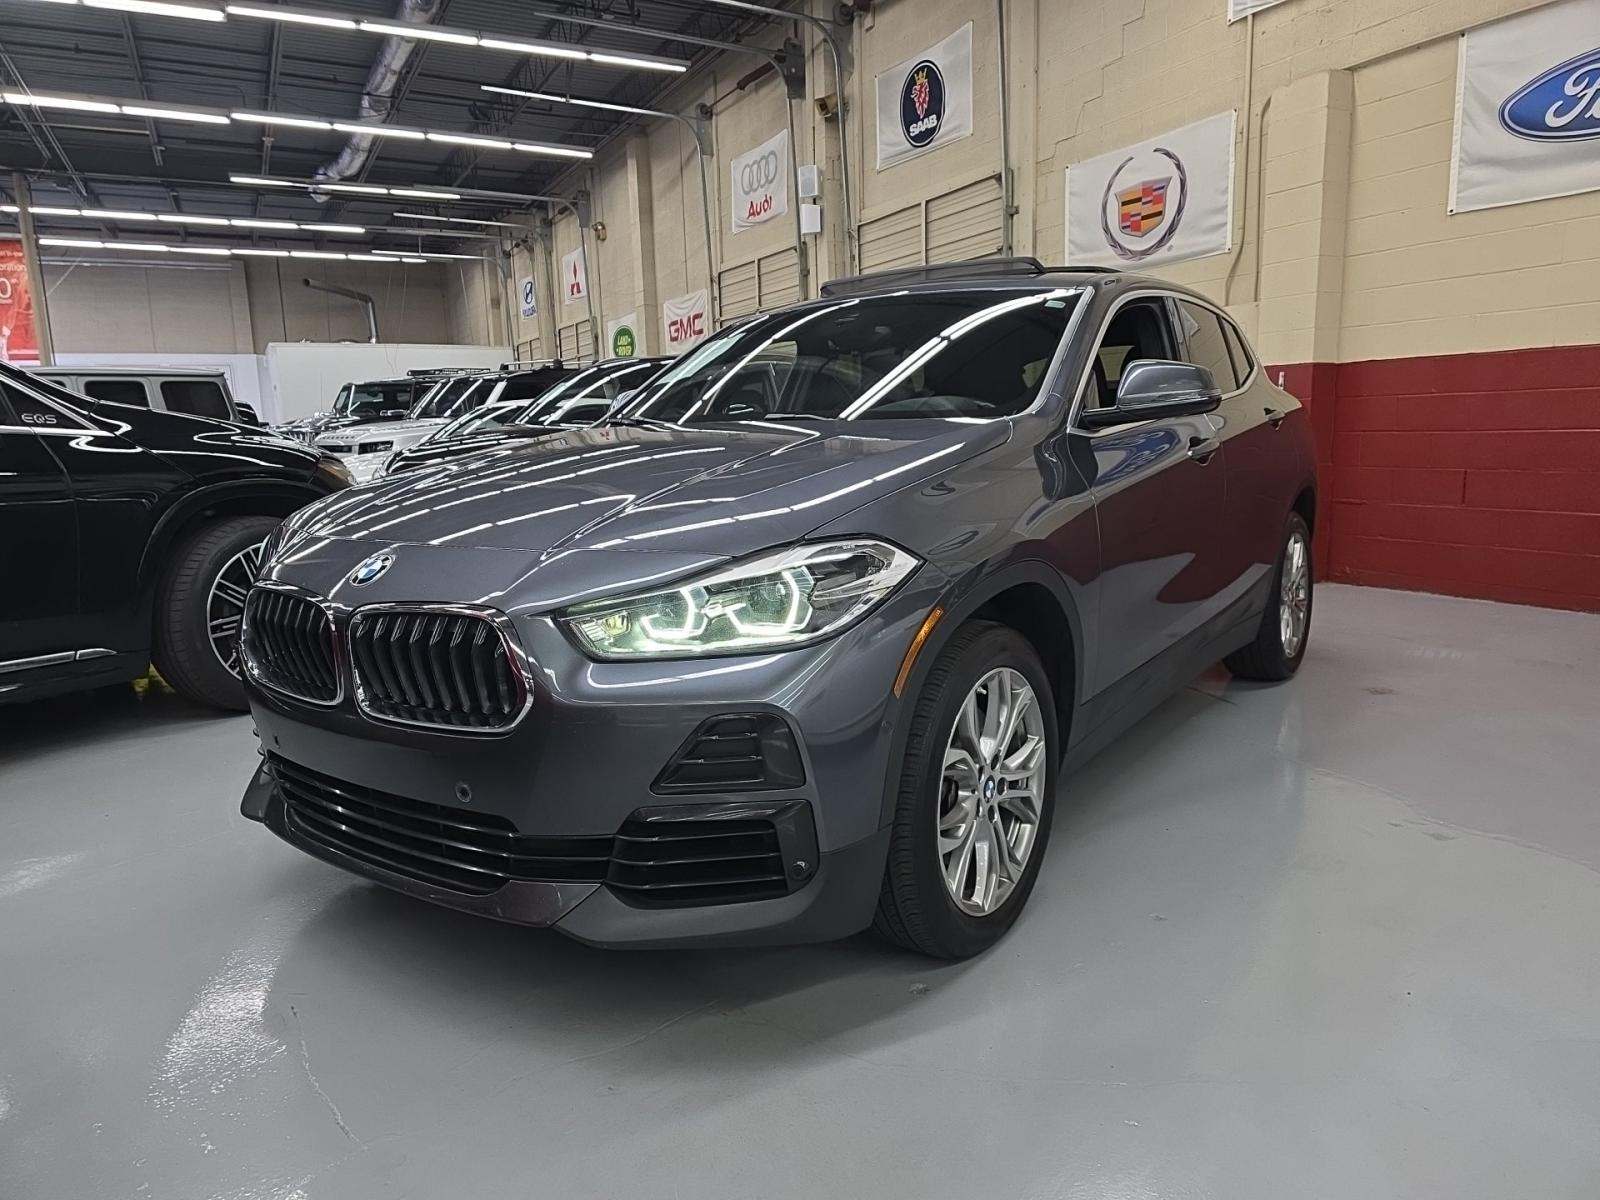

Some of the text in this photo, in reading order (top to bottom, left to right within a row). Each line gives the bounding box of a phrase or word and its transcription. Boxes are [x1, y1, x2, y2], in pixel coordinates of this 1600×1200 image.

[909, 113, 938, 137] SAAB
[746, 193, 773, 220] Audi
[668, 311, 704, 342] GMC
[21, 413, 57, 424] EQS
